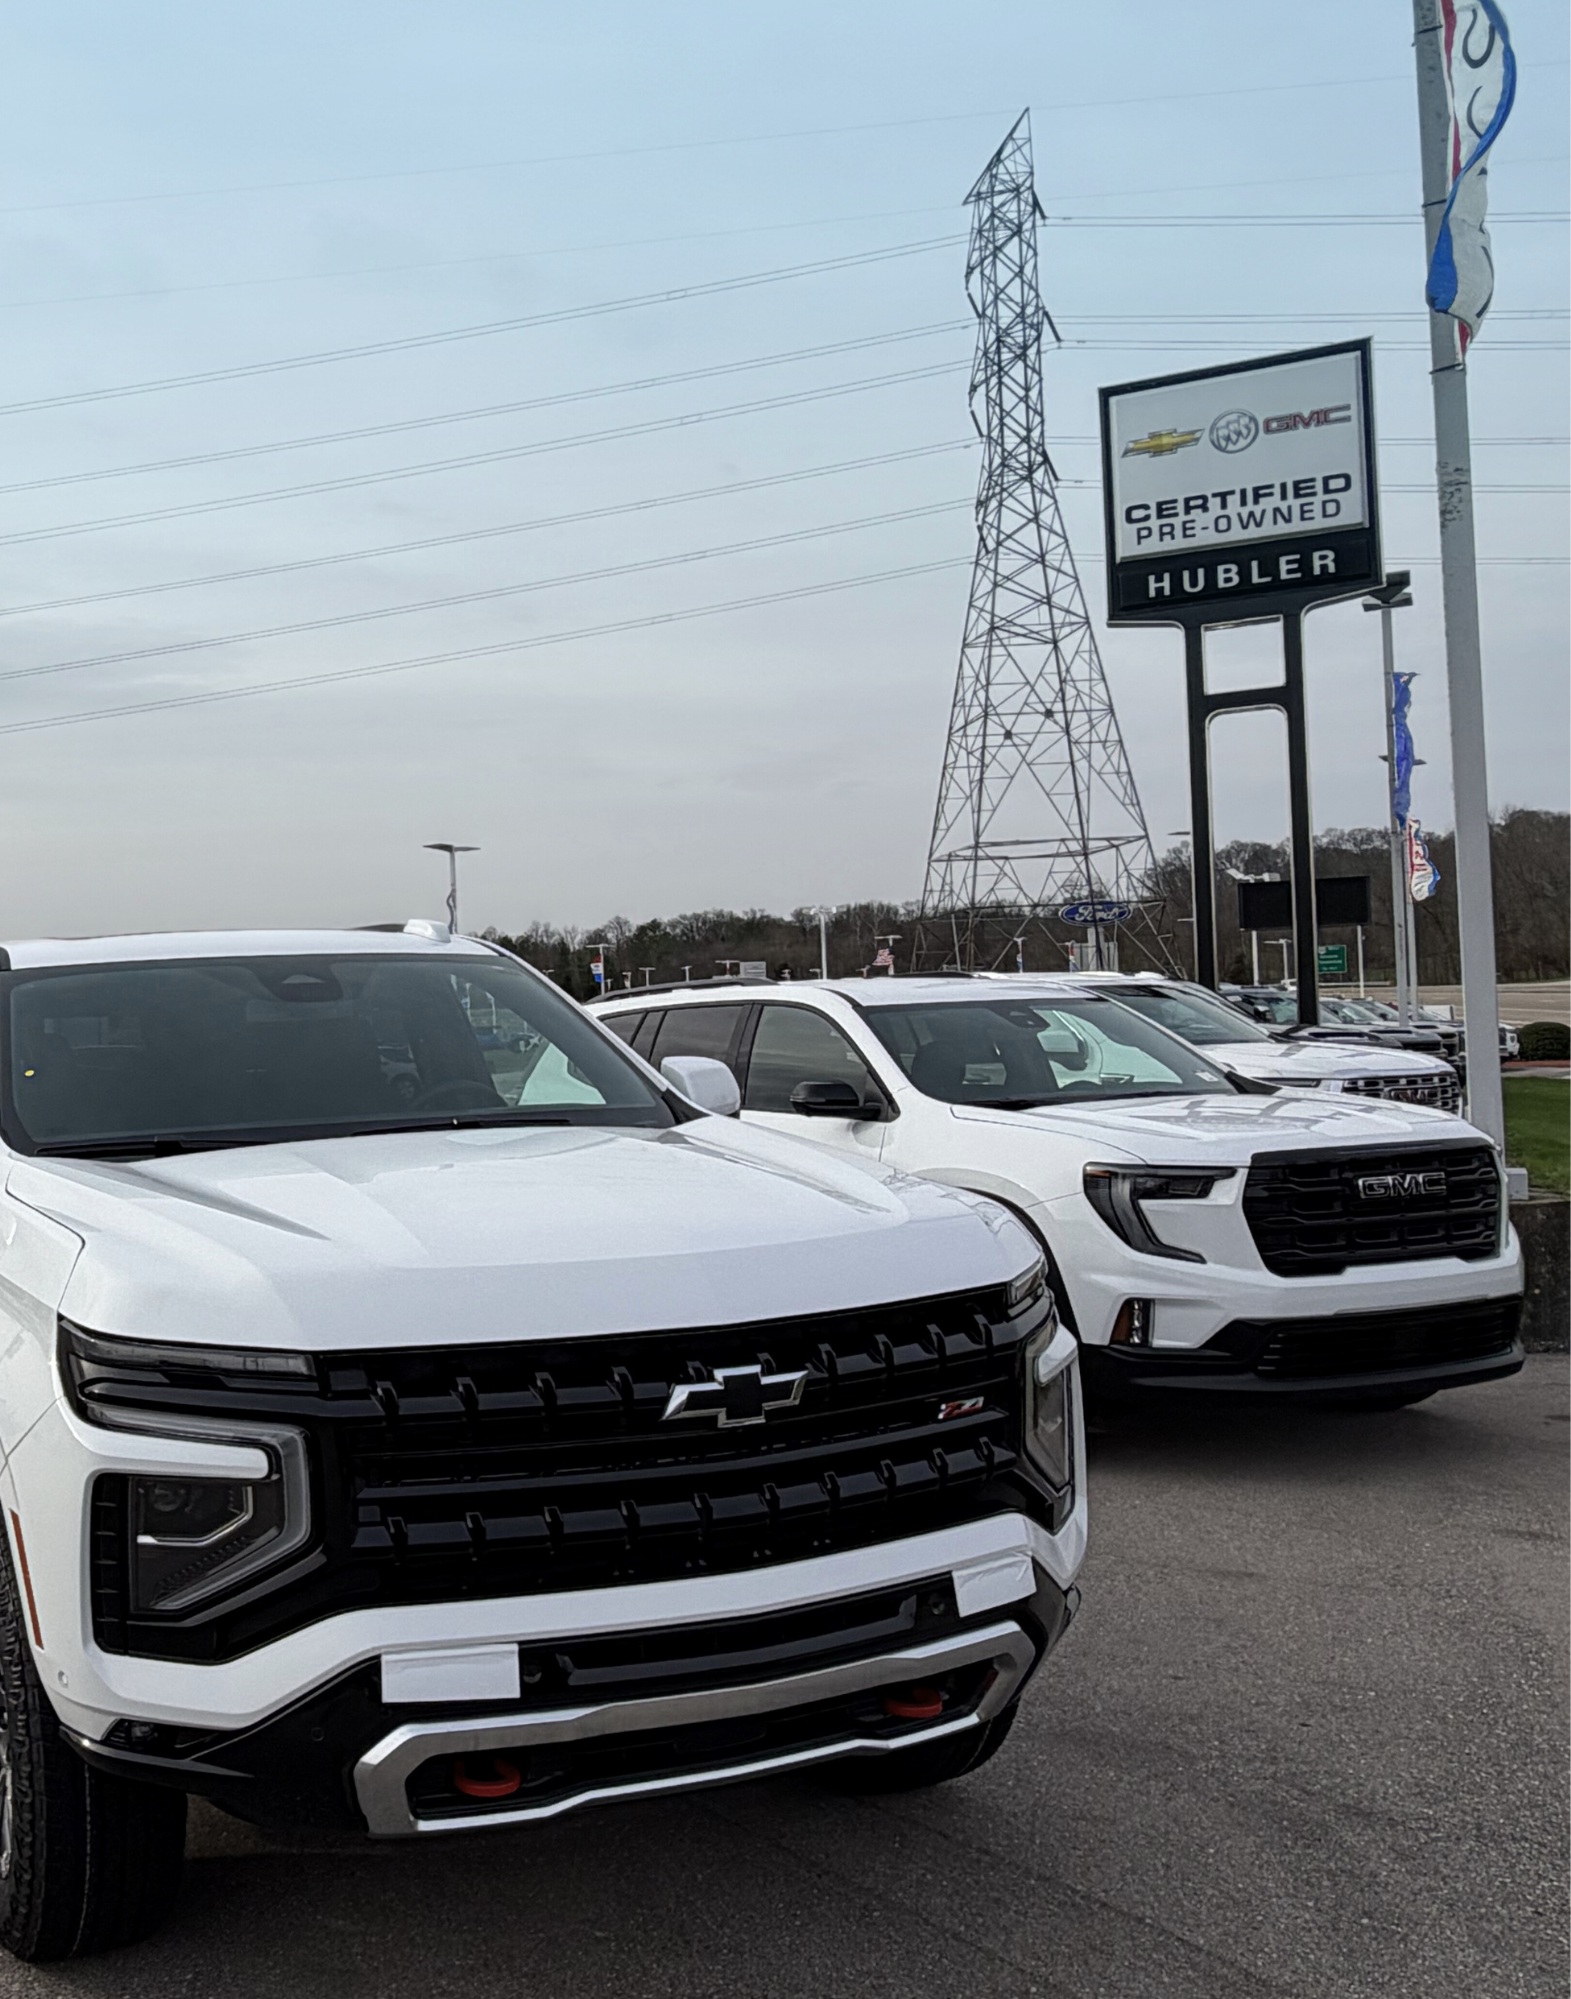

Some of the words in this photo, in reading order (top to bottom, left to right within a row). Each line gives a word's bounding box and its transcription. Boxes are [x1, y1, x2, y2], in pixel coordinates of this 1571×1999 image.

[1263, 404, 1352, 435] GMC
[1125, 472, 1352, 524] CERTIFIED
[1136, 499, 1341, 545] PRE-OWNED
[1148, 550, 1336, 598] HUBLER
[1072, 904, 1122, 921] Ford
[1358, 1171, 1447, 1199] GMC
